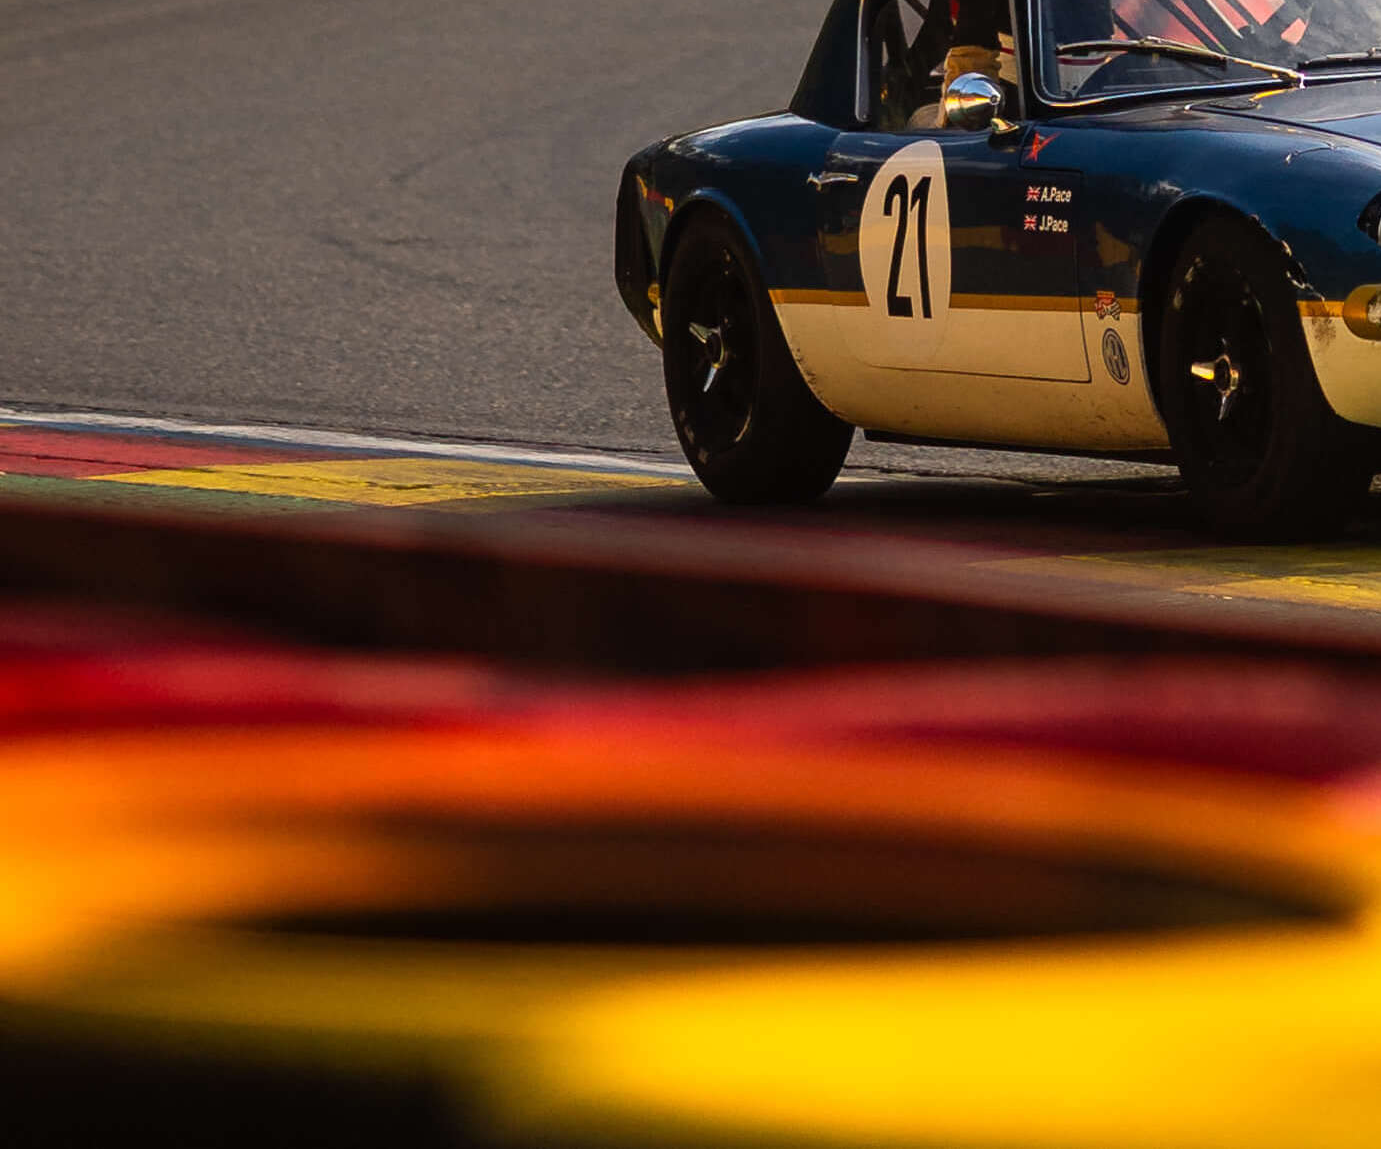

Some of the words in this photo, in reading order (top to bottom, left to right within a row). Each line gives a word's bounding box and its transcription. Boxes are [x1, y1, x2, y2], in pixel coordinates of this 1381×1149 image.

[1040, 187, 1072, 202] A.Pace
[1039, 215, 1069, 232] J.Pace
[883, 174, 933, 319] 21
